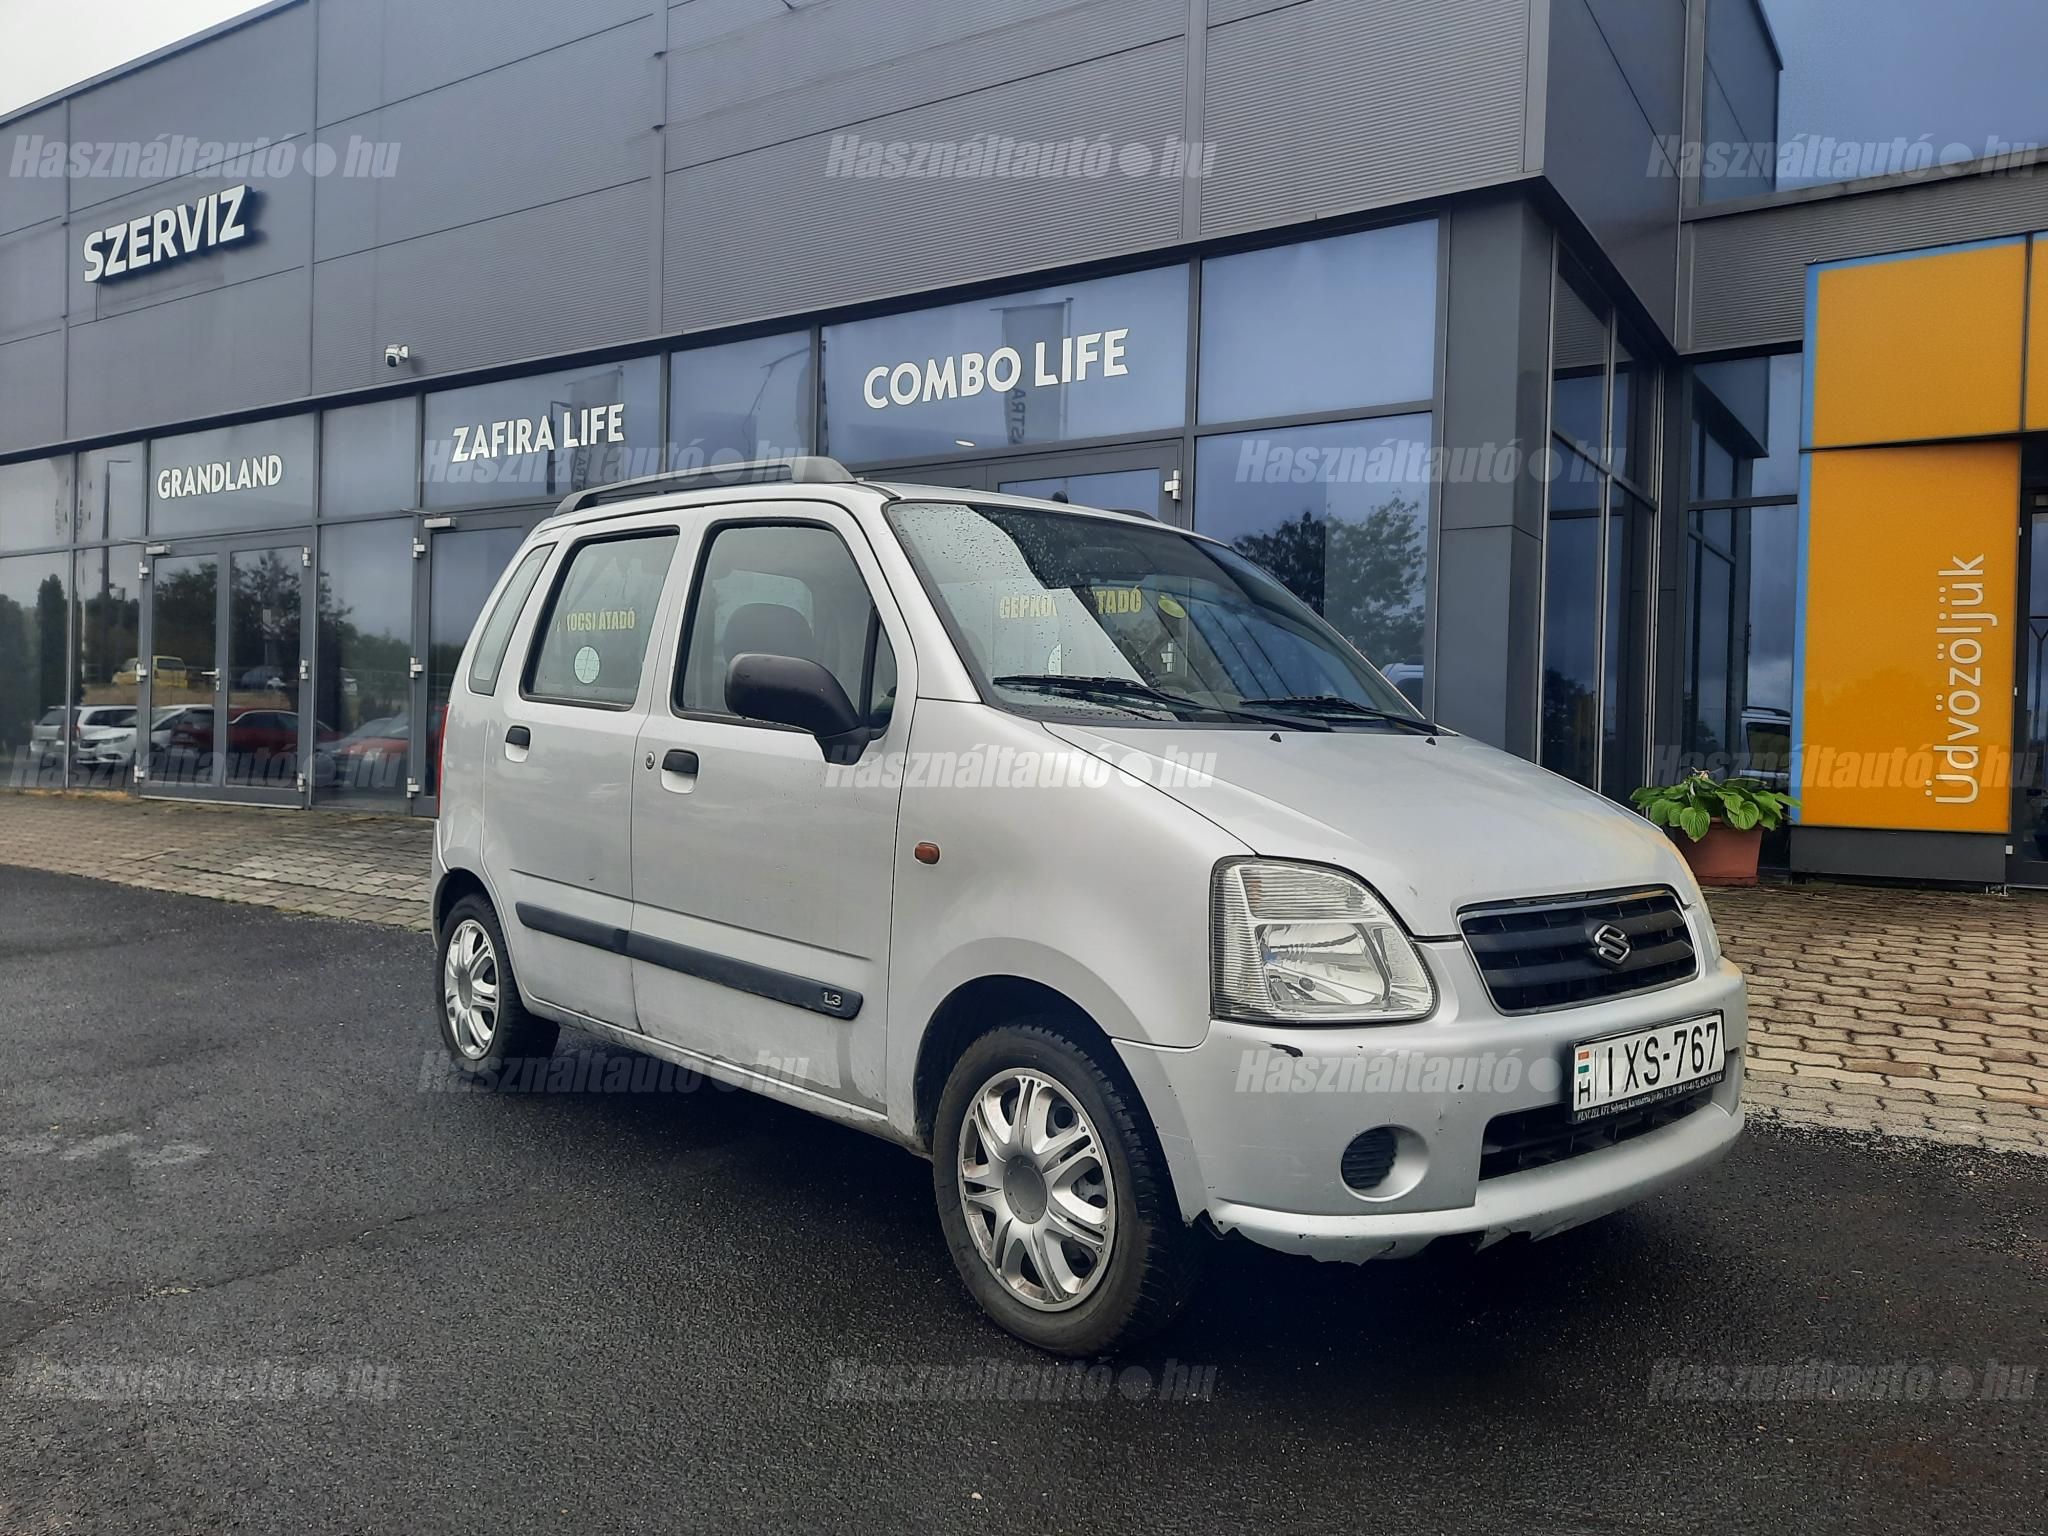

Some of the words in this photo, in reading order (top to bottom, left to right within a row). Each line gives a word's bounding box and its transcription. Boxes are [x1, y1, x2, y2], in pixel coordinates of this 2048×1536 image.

[83, 184, 252, 283] SZERVIZ
[863, 346, 1022, 409] COMBO
[1034, 328, 1129, 387] LIFE
[451, 412, 555, 463] ZAFIRA
[562, 403, 625, 449] LIFE
[157, 454, 283, 499] GRANDLAND
[1924, 553, 1998, 804] Üdvözöljük
[1577, 1078, 1591, 1105] H
[1607, 1023, 1718, 1097] IXS-767
